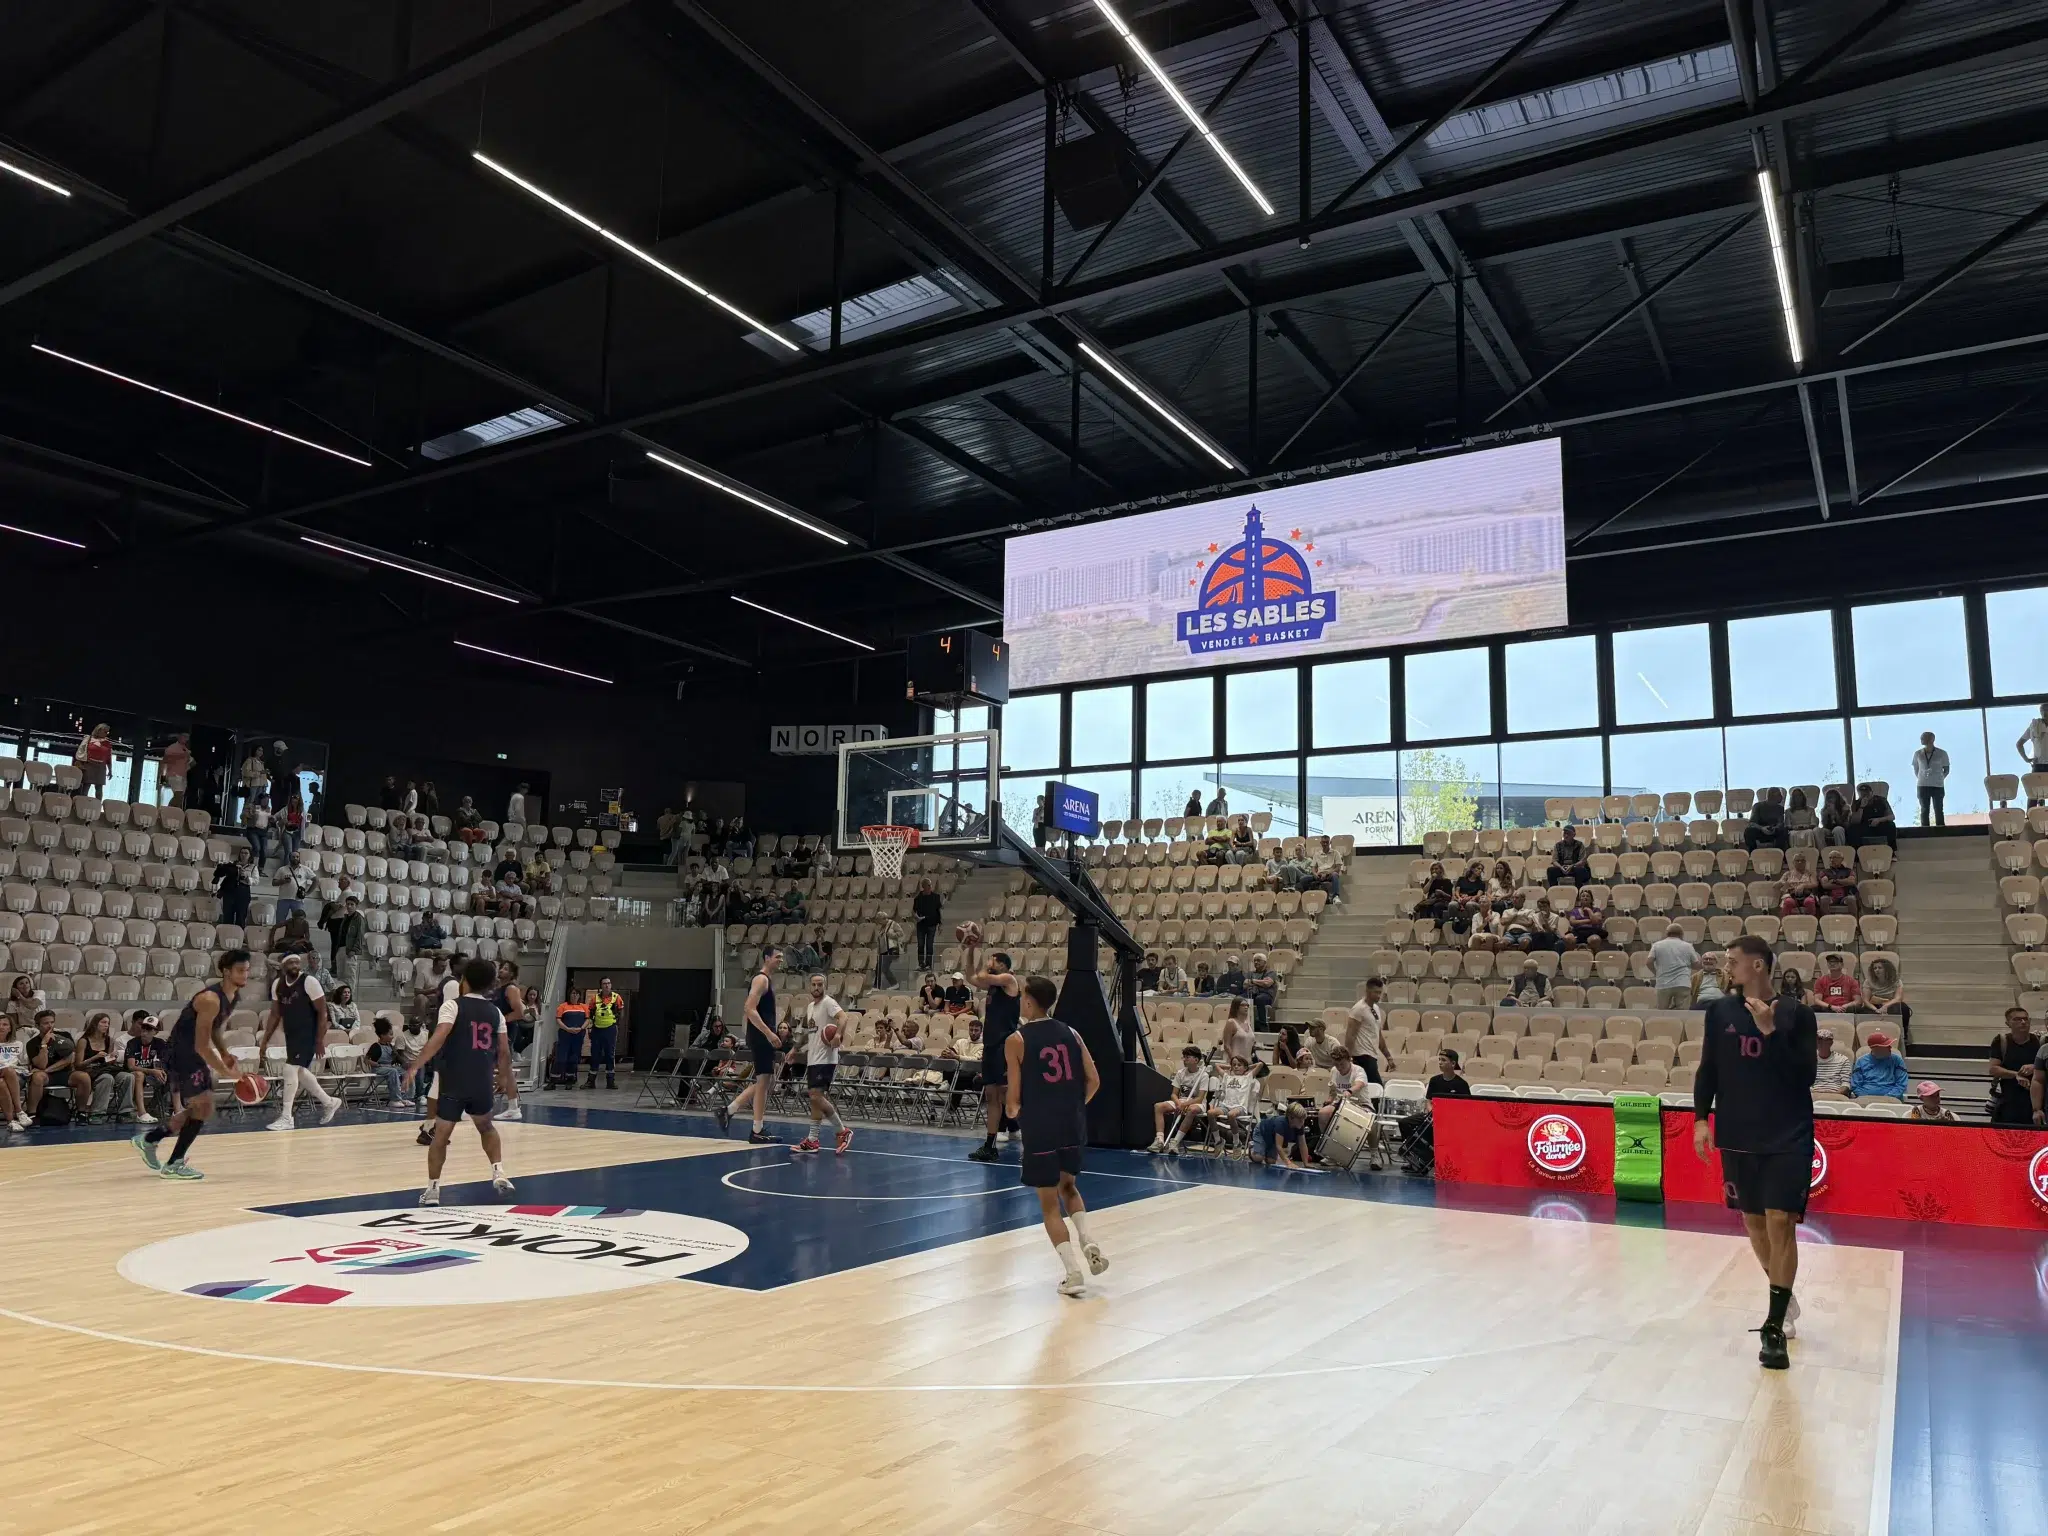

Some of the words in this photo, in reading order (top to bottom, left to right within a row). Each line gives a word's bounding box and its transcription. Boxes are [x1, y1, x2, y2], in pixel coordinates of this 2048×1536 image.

[1186, 612, 1228, 636] LES
[1232, 598, 1326, 630] SABLES
[940, 636, 951, 654] 4
[1201, 636, 1244, 650] VENDÉE
[1265, 628, 1310, 642] BASKET
[992, 643, 1000, 661] 4
[1063, 798, 1090, 816] ARENA
[1365, 826, 1394, 834] FORUM
[470, 1020, 494, 1050] 13
[1739, 1035, 1762, 1057] 10
[1039, 1044, 1074, 1082] 31
[1534, 1140, 1581, 1156] Fournée
[1534, 1168, 1556, 1180] Saveur
